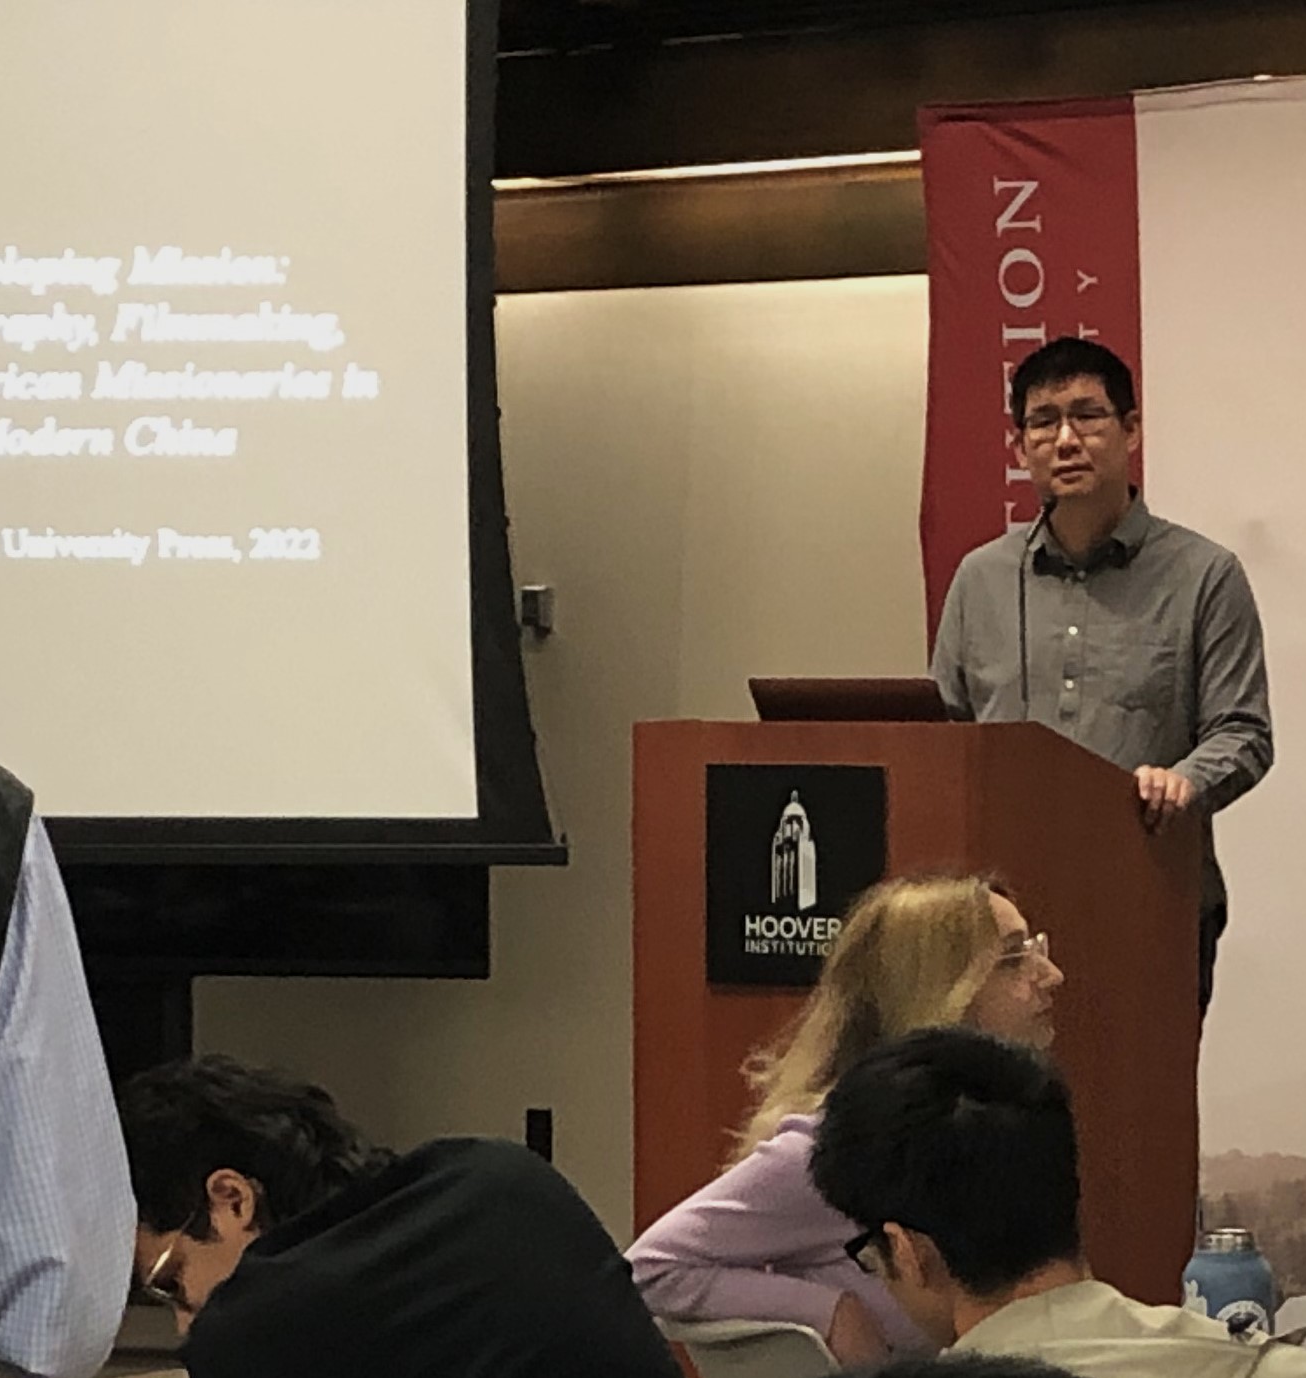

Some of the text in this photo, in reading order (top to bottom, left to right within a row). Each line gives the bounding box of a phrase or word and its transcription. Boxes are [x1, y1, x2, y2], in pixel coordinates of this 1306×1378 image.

[128, 246, 291, 285] Mission:
[111, 303, 345, 350] Filmmaking,
[93, 362, 331, 399] Missionaries
[344, 363, 380, 398] in
[124, 417, 237, 456] China
[2, 528, 151, 565] University
[158, 528, 243, 562] Press,
[249, 528, 321, 559] 2022
[745, 914, 843, 939] HOOVER
[745, 939, 837, 956] INSTITUTIO
